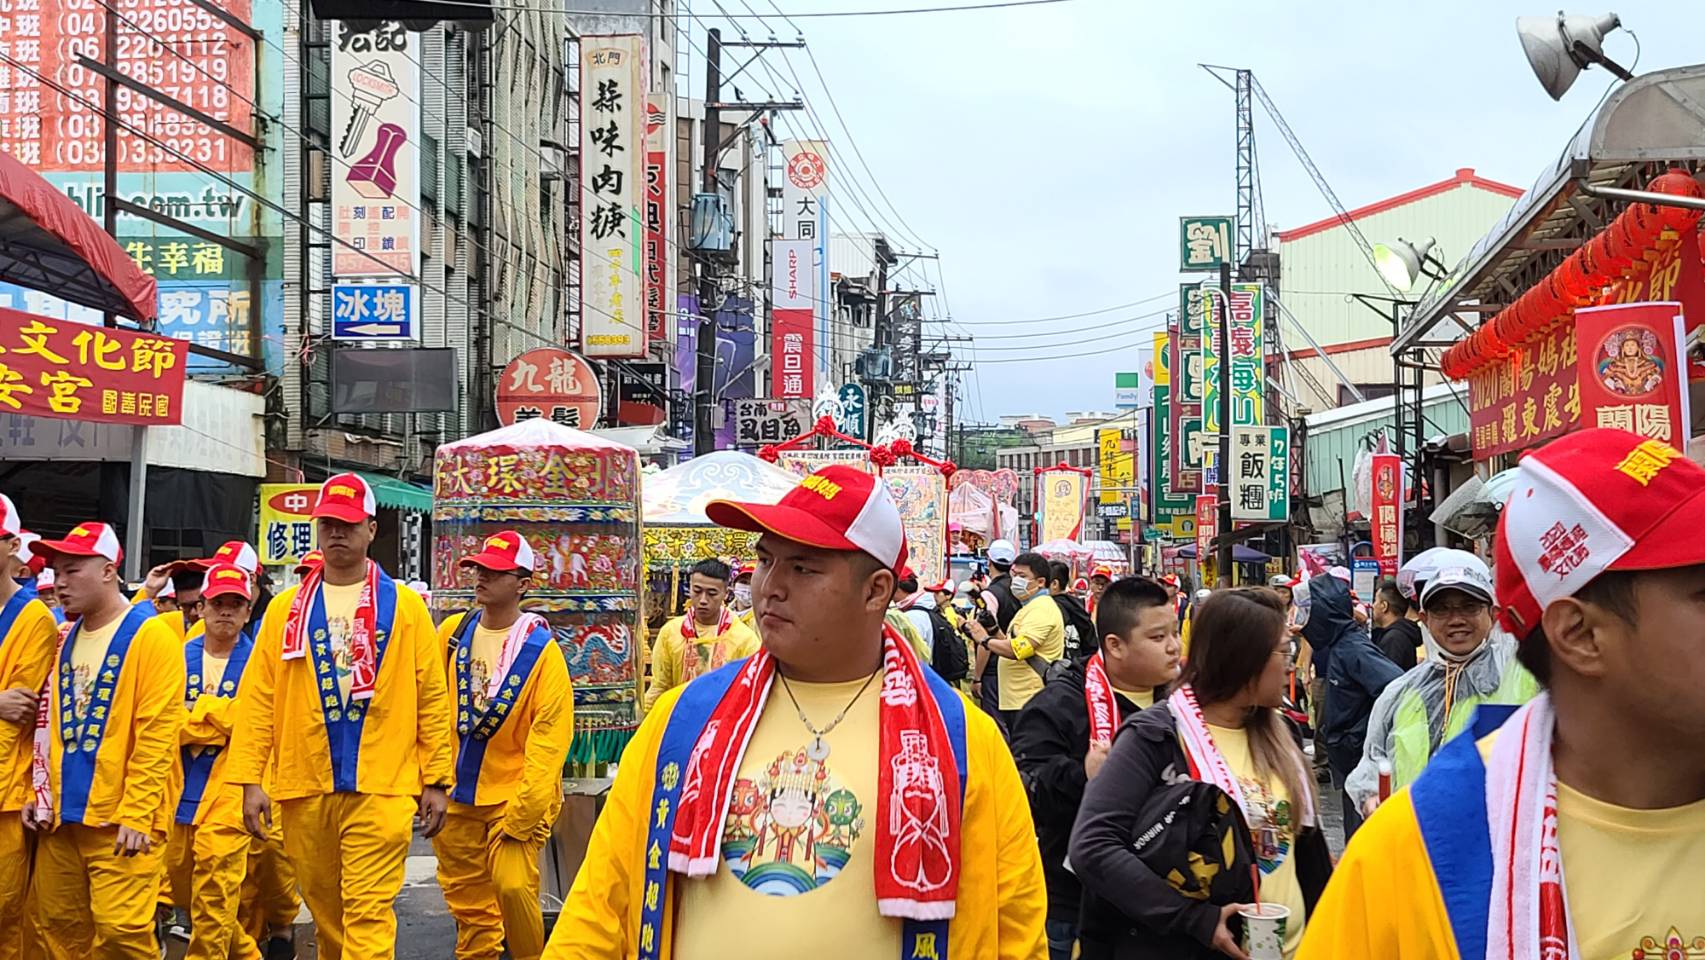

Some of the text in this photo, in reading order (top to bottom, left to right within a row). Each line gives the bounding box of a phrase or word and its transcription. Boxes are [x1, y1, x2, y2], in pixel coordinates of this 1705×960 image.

[592, 53, 620, 65] 北門
[796, 196, 816, 240] 大同
[788, 249, 798, 299] SHARP
[336, 289, 406, 322] 冰塊
[510, 357, 582, 396] 九龍
[783, 332, 803, 399] 震旦通
[741, 402, 768, 417] 台南
[1240, 434, 1267, 447] 專業
[1240, 452, 1265, 510] 飯糰
[267, 521, 312, 561] 修理
